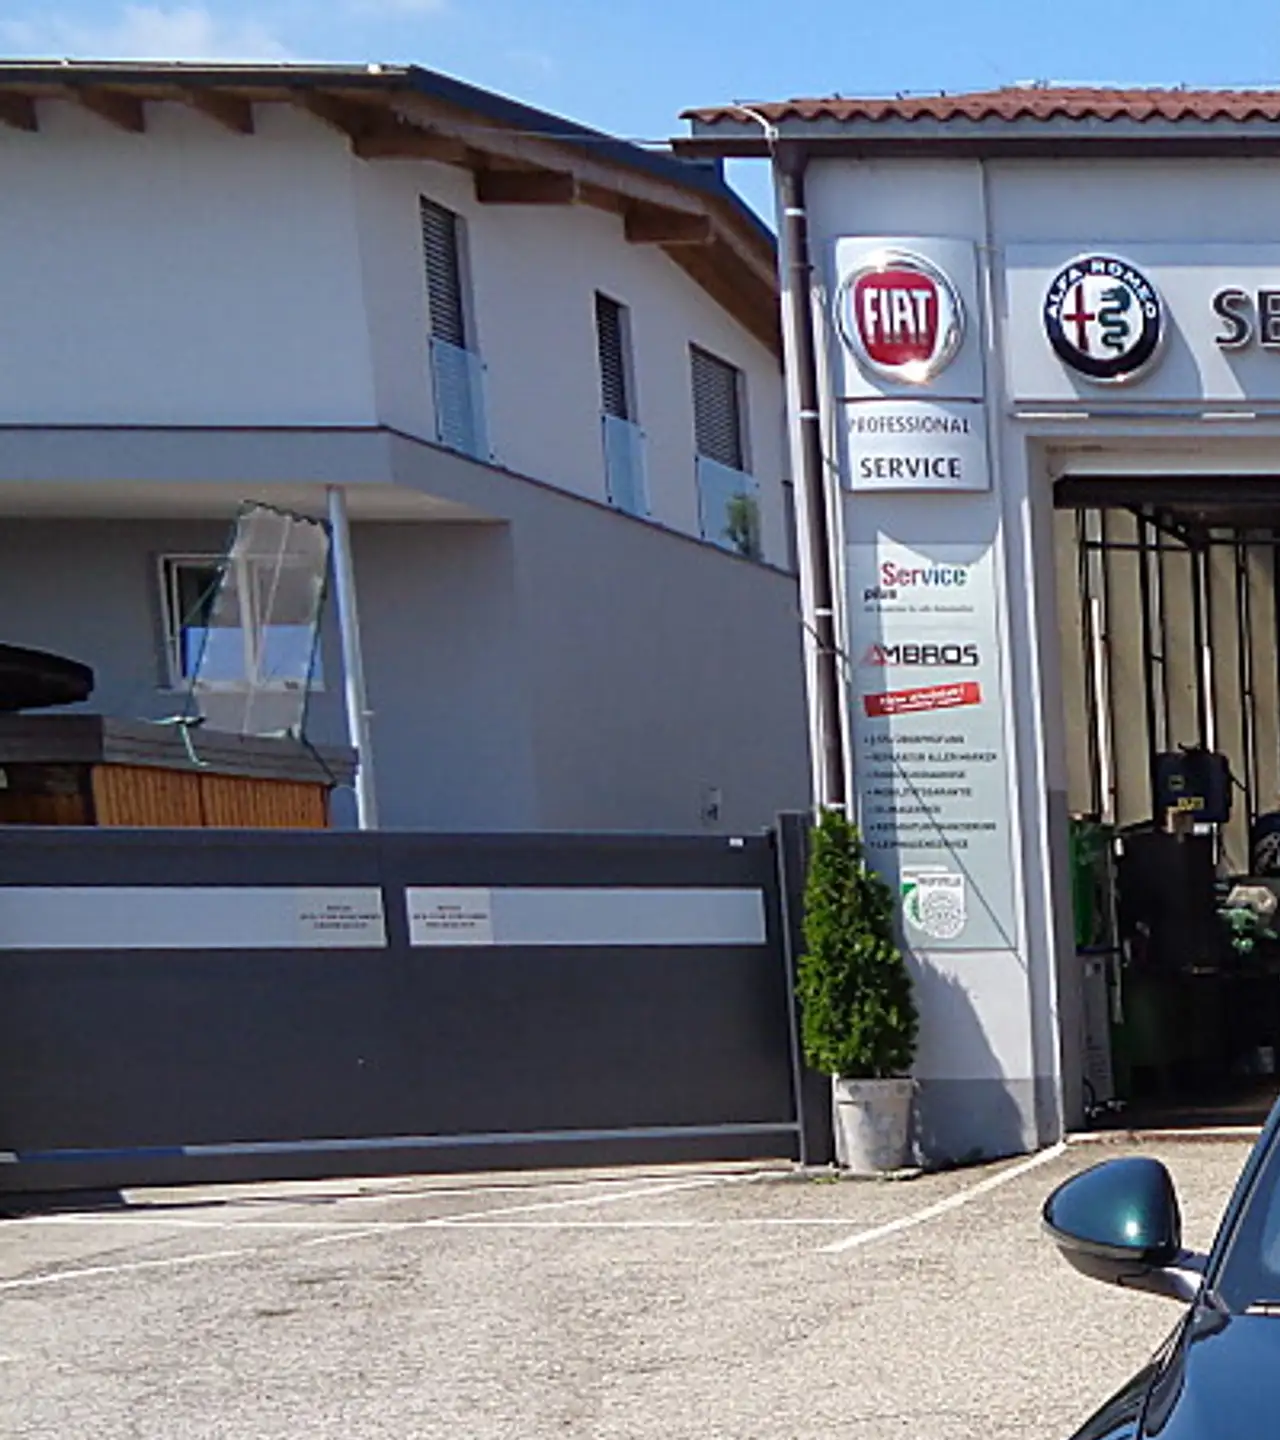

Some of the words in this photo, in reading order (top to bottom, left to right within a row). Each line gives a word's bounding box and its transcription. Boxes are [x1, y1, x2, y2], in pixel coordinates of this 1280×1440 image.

[1047, 268, 1084, 318] ALFA
[1090, 260, 1157, 318] ROMEO
[863, 288, 931, 345] FIAT
[849, 415, 970, 435] PROFESSIONAL
[860, 457, 962, 479] SERVICE
[880, 561, 967, 586] Service
[864, 644, 979, 667] AMBROS
